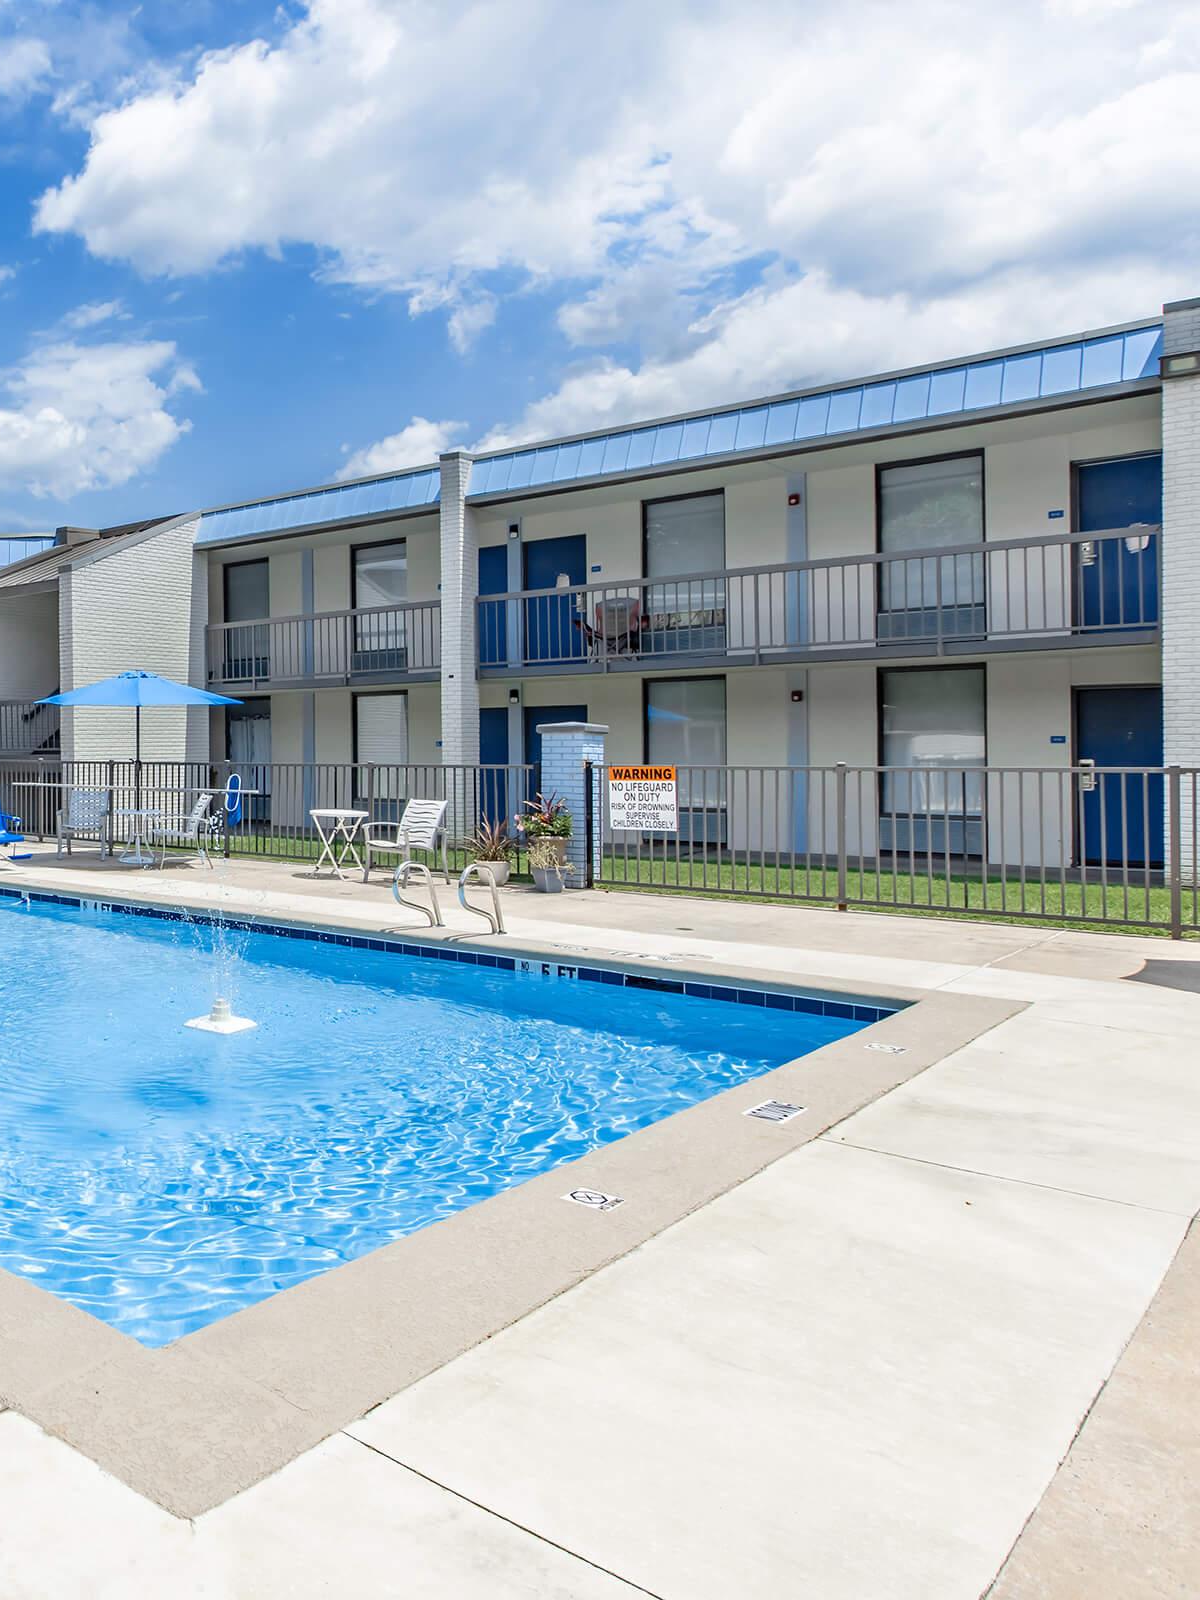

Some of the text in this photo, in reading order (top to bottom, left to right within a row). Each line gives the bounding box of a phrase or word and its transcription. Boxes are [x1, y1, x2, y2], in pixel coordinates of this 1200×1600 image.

[613, 768, 672, 779] WARNING
[611, 782, 673, 792] NO LIFEGUARD
[624, 793, 660, 801] ON DUTY
[625, 812, 660, 820] SUPERVISE
[613, 820, 674, 829] CHILDREN CLOSELY
[557, 965, 576, 979] FT
